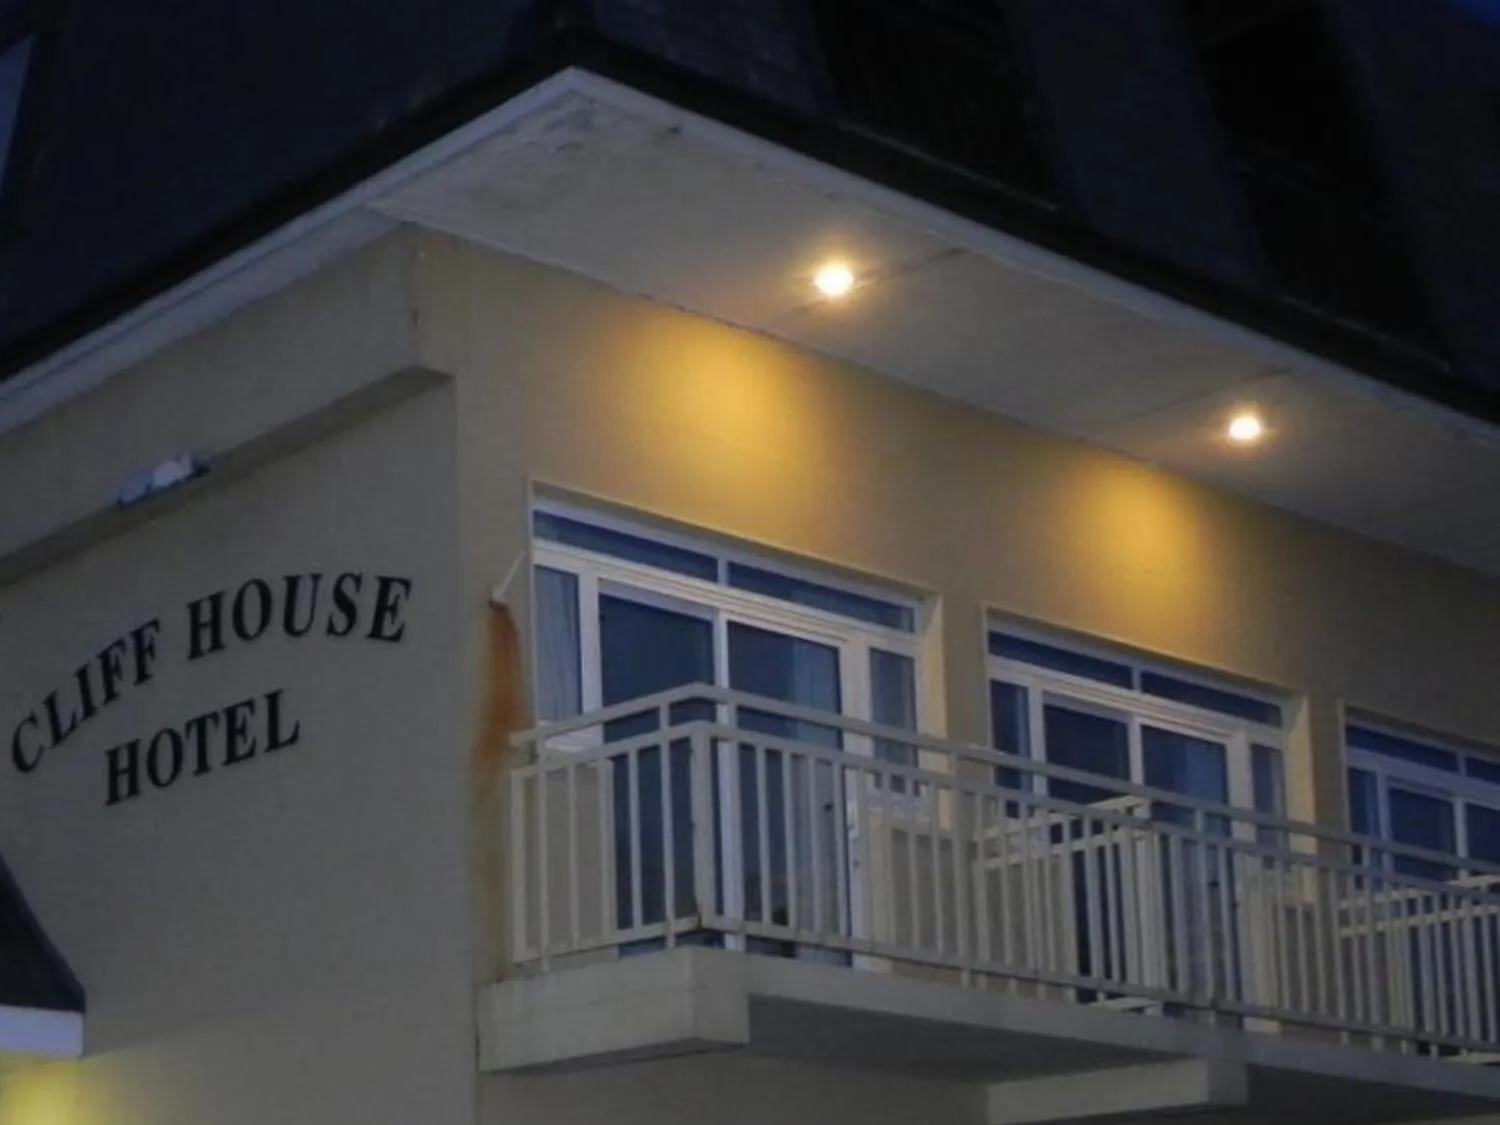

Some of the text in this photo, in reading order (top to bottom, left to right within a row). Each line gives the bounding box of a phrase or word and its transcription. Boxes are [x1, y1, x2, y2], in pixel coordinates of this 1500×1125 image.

[11, 572, 412, 774] CLIFF HOUSE
[104, 688, 300, 806] HOTEL
